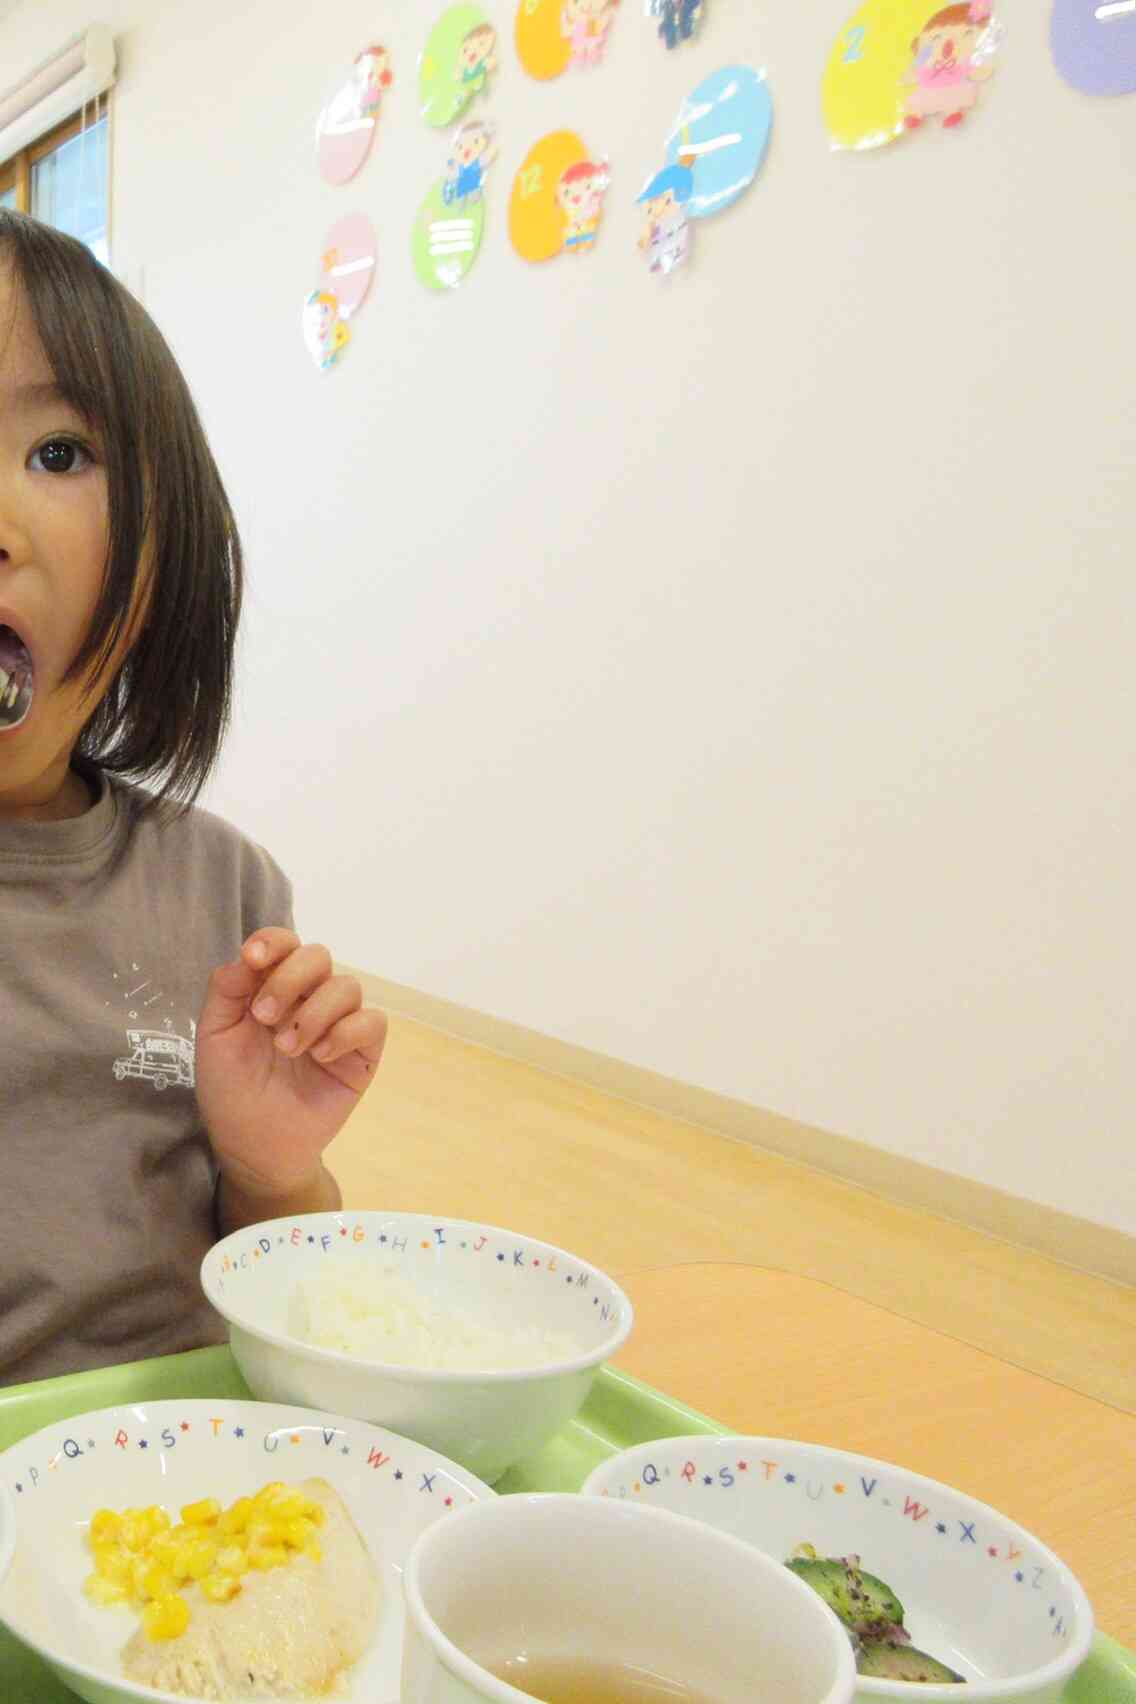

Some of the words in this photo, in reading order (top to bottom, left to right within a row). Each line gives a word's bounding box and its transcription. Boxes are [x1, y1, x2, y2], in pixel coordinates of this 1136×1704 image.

[258, 1238, 271, 1253] D
[290, 1227, 303, 1247] E
[320, 1234, 332, 1253] F
[352, 1224, 365, 1243] G
[391, 1236, 409, 1253] H
[434, 1228, 446, 1245] I
[473, 1236, 488, 1252] J
[513, 1250, 524, 1267] K
[575, 1272, 590, 1288] M
[599, 1303, 610, 1321] N
[29, 1466, 40, 1487] P
[63, 1438, 84, 1458] Q
[115, 1429, 129, 1450] R
[161, 1427, 176, 1448] S
[208, 1417, 225, 1437] T
[264, 1433, 278, 1453] U
[321, 1426, 336, 1446] V
[367, 1446, 391, 1469] W
[419, 1472, 437, 1493] X
[642, 1463, 661, 1485] Q
[681, 1460, 696, 1483] R
[719, 1466, 735, 1488] S
[760, 1459, 779, 1481] T
[806, 1479, 824, 1501] U
[860, 1476, 878, 1497] V
[903, 1495, 929, 1521] W
[959, 1519, 977, 1544] X
[1032, 1566, 1044, 1589] Z
